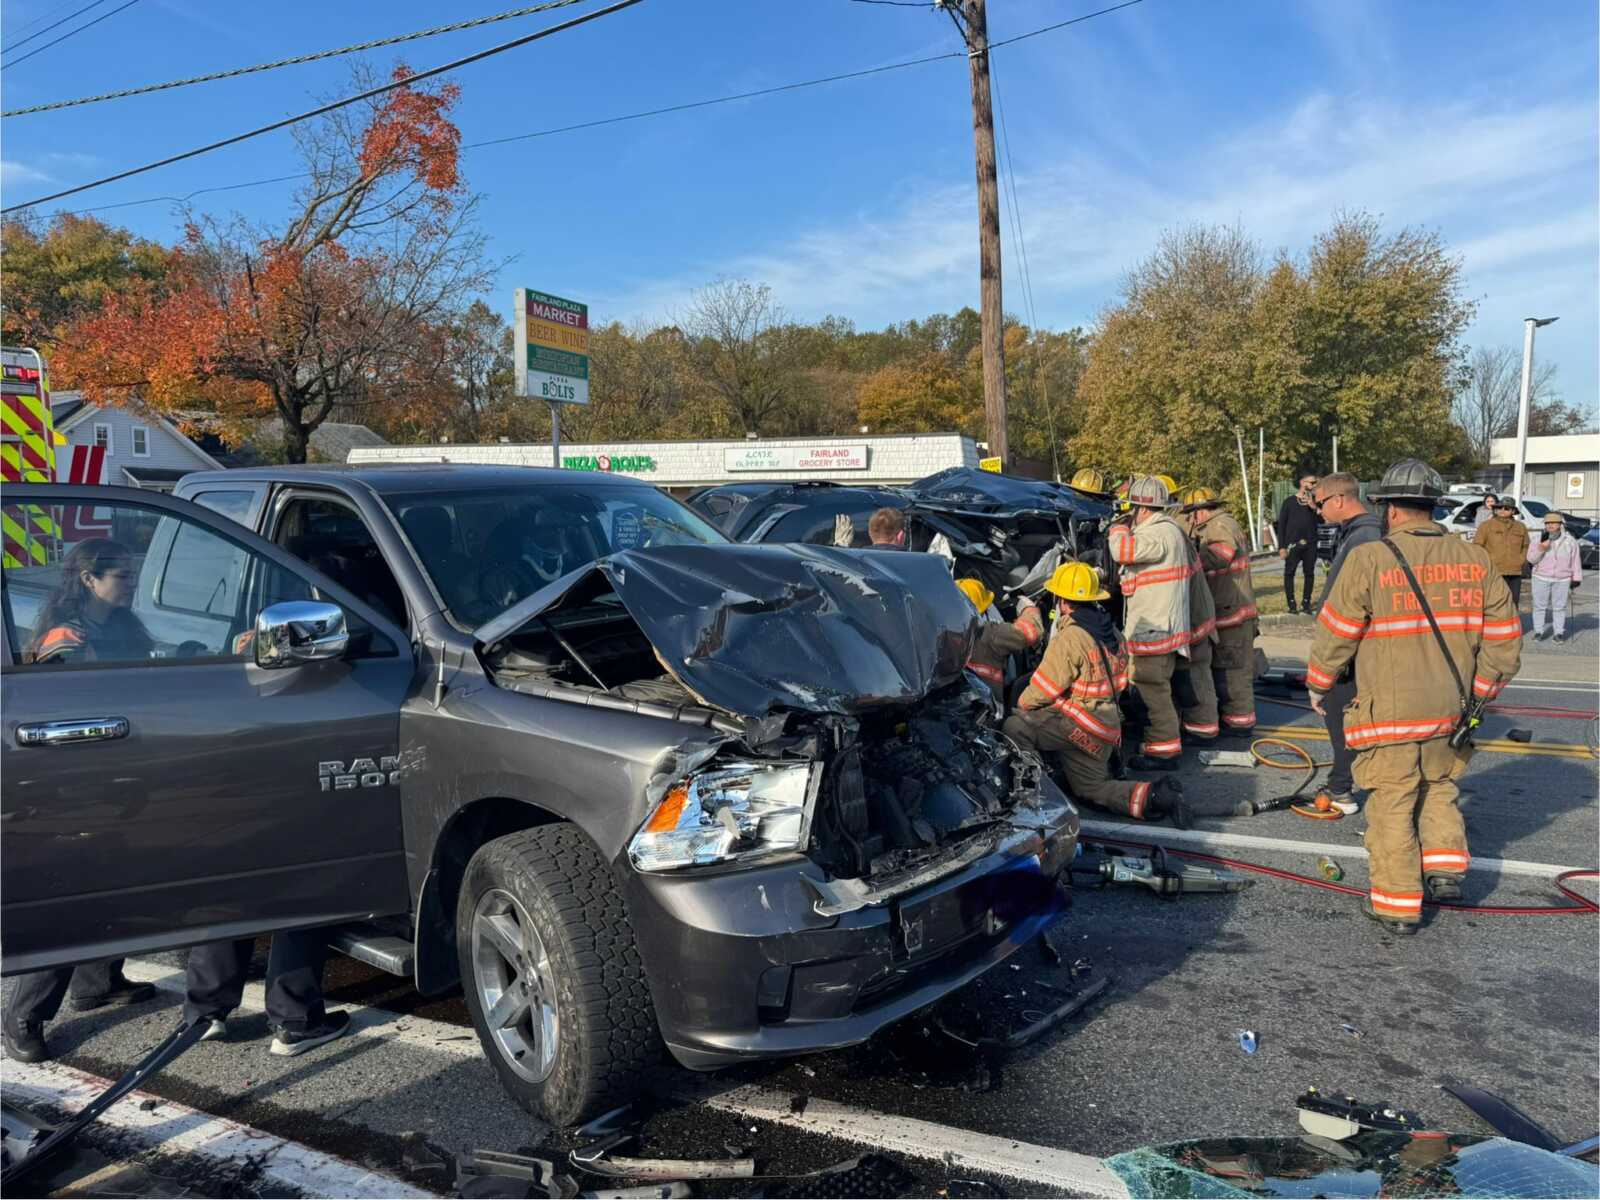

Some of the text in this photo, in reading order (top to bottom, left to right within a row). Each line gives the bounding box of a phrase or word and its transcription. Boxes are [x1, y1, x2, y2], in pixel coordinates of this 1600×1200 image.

[531, 293, 581, 312] FAIRLAND PLAZA
[533, 303, 580, 326] MARKET
[529, 322, 587, 349] BEER WINE
[799, 458, 861, 467] GROCERY STORE
[811, 449, 850, 458] FAIRLAND
[1391, 591, 1422, 612] FIR
[1449, 588, 1483, 608] EMS
[319, 754, 401, 776] RAM
